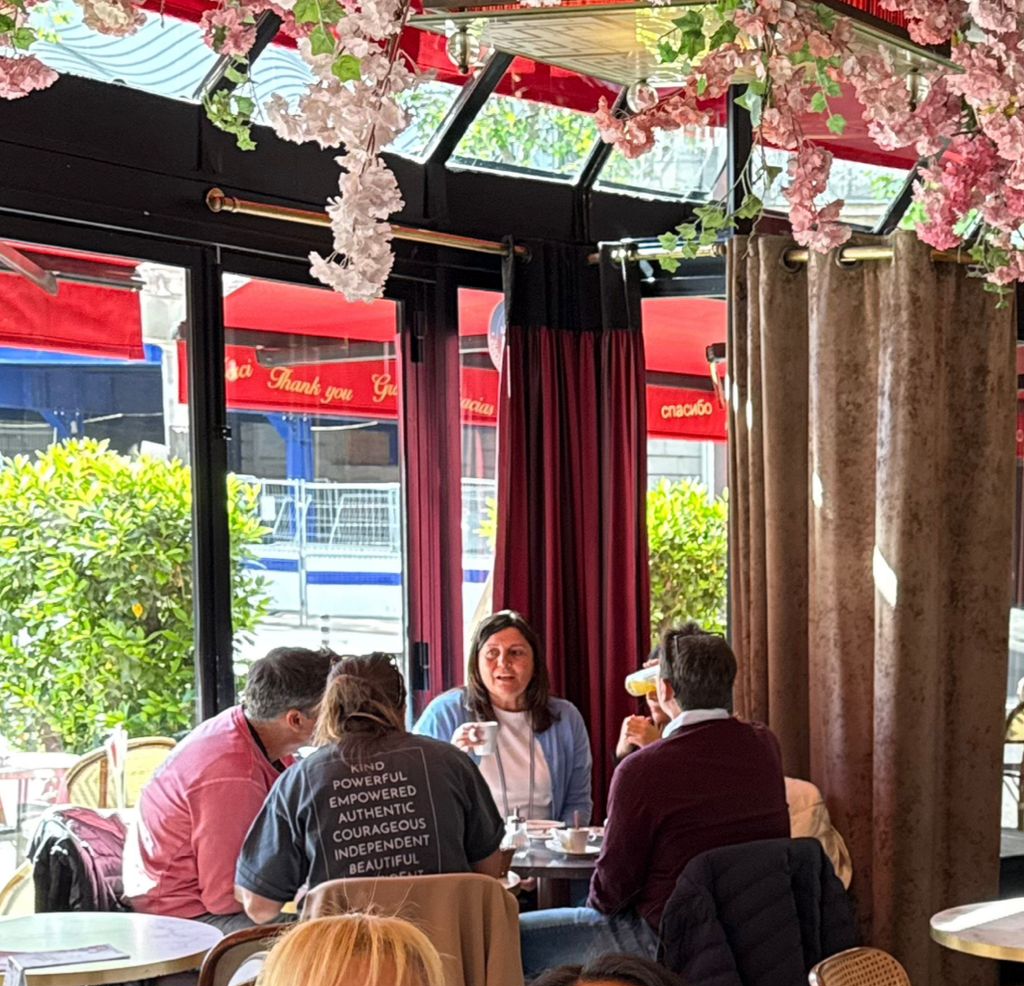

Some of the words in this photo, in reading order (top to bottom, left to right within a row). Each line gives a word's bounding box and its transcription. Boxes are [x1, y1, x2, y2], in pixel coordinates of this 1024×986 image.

[267, 366, 322, 396] Thank
[320, 385, 354, 403] you
[661, 399, 713, 419] спасибо
[350, 761, 385, 774] KIND
[332, 771, 408, 790] POWERFUL
[329, 785, 417, 808] EMPOWERED
[338, 802, 415, 824] AUTHENTIC
[332, 818, 426, 842] COURAGEOUS
[334, 834, 430, 861] INDEPENDENT
[349, 853, 419, 875] BEAUTIFUL
